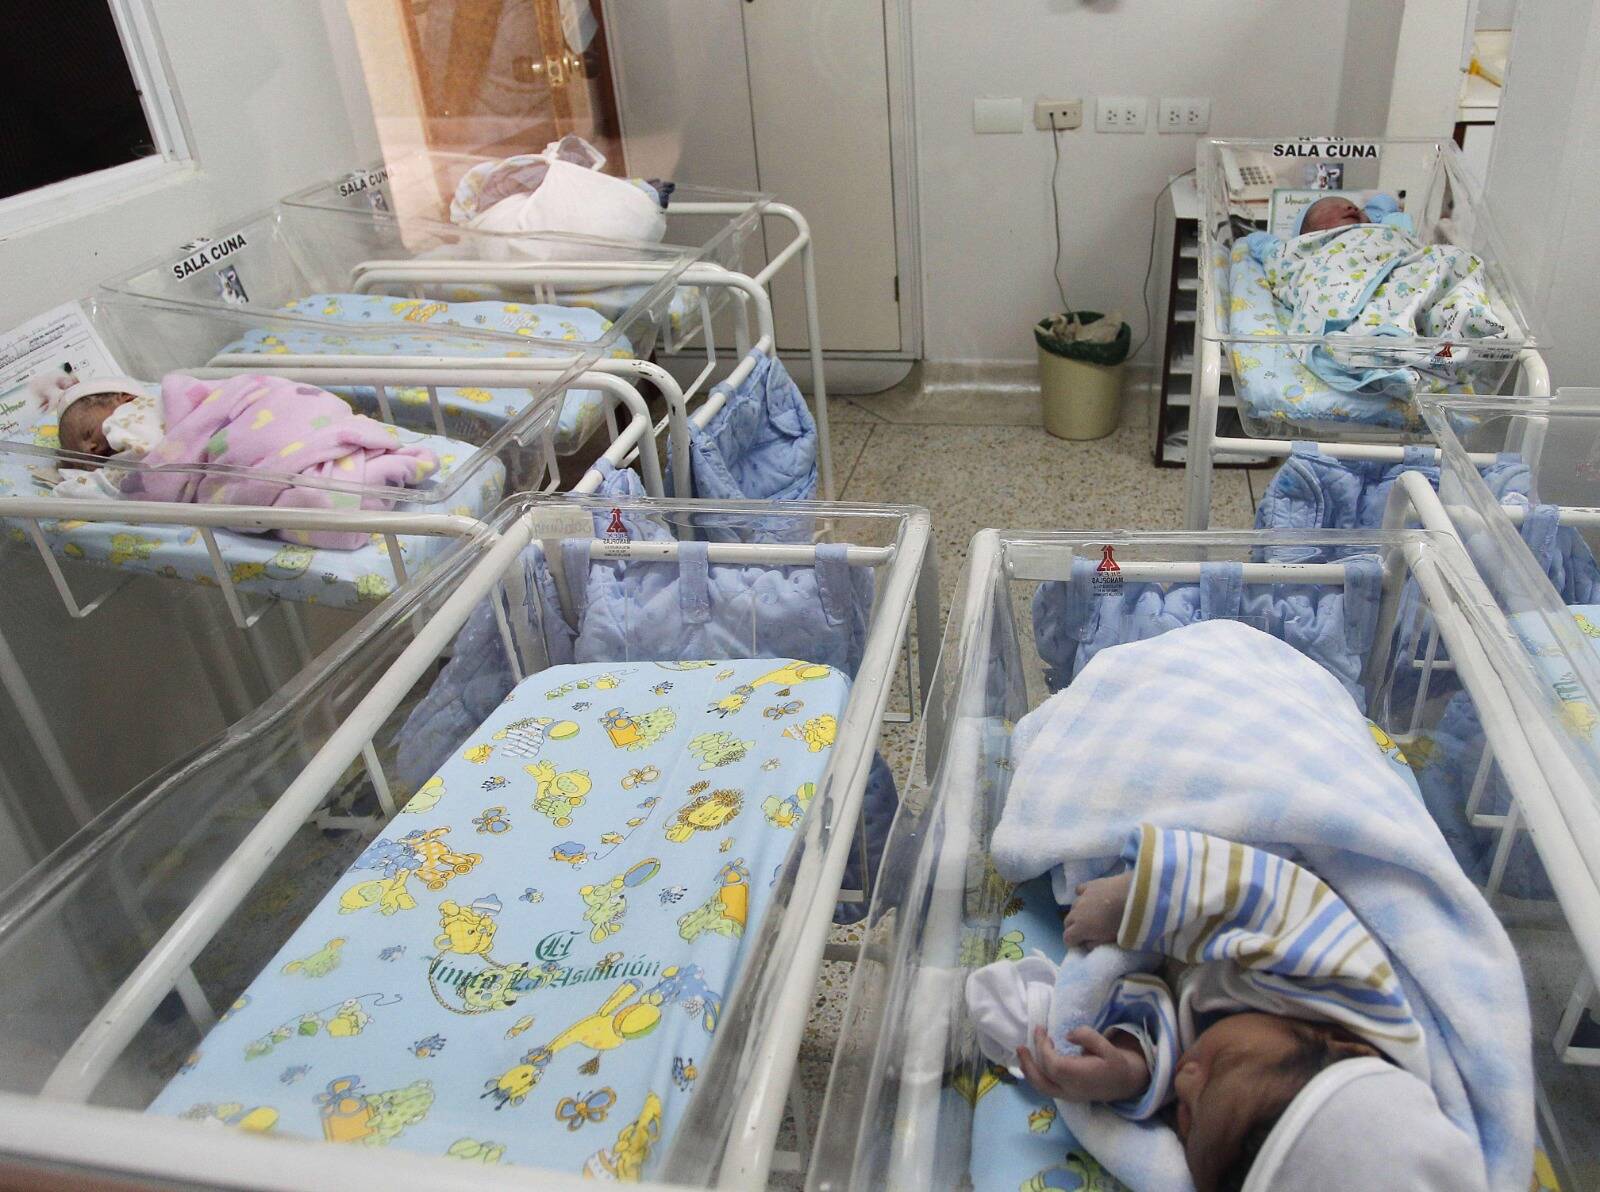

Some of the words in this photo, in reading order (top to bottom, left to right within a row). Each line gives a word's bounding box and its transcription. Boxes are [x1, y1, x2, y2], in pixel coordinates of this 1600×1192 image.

[1273, 144, 1319, 157] SALA
[1326, 144, 1377, 158] CUNA
[340, 178, 368, 197] SALA
[369, 168, 392, 186] CUN
[173, 252, 210, 279] SALA
[211, 234, 247, 260] CUNA
